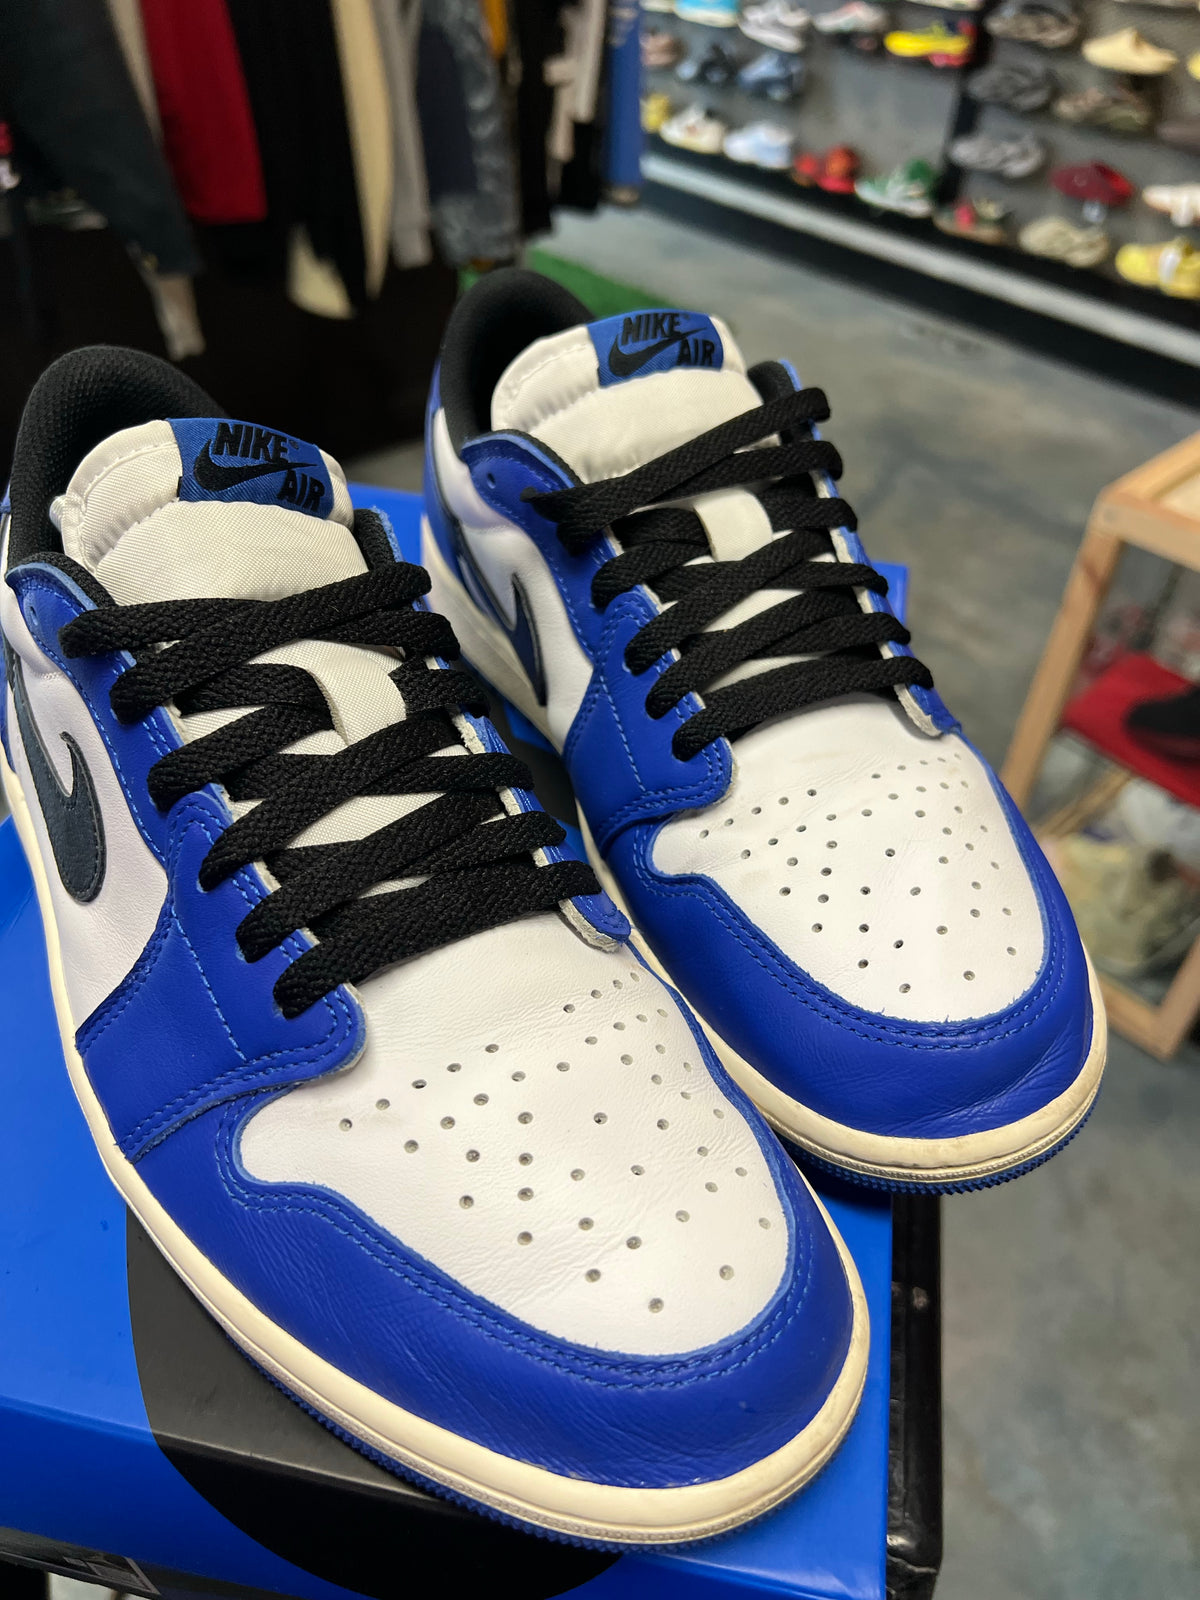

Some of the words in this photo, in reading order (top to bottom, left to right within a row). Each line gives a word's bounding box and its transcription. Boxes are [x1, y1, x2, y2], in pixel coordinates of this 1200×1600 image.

[621, 312, 682, 346] NIKE
[676, 336, 715, 366] AIR
[212, 422, 289, 463] NIKE
[276, 469, 325, 512] AIR
